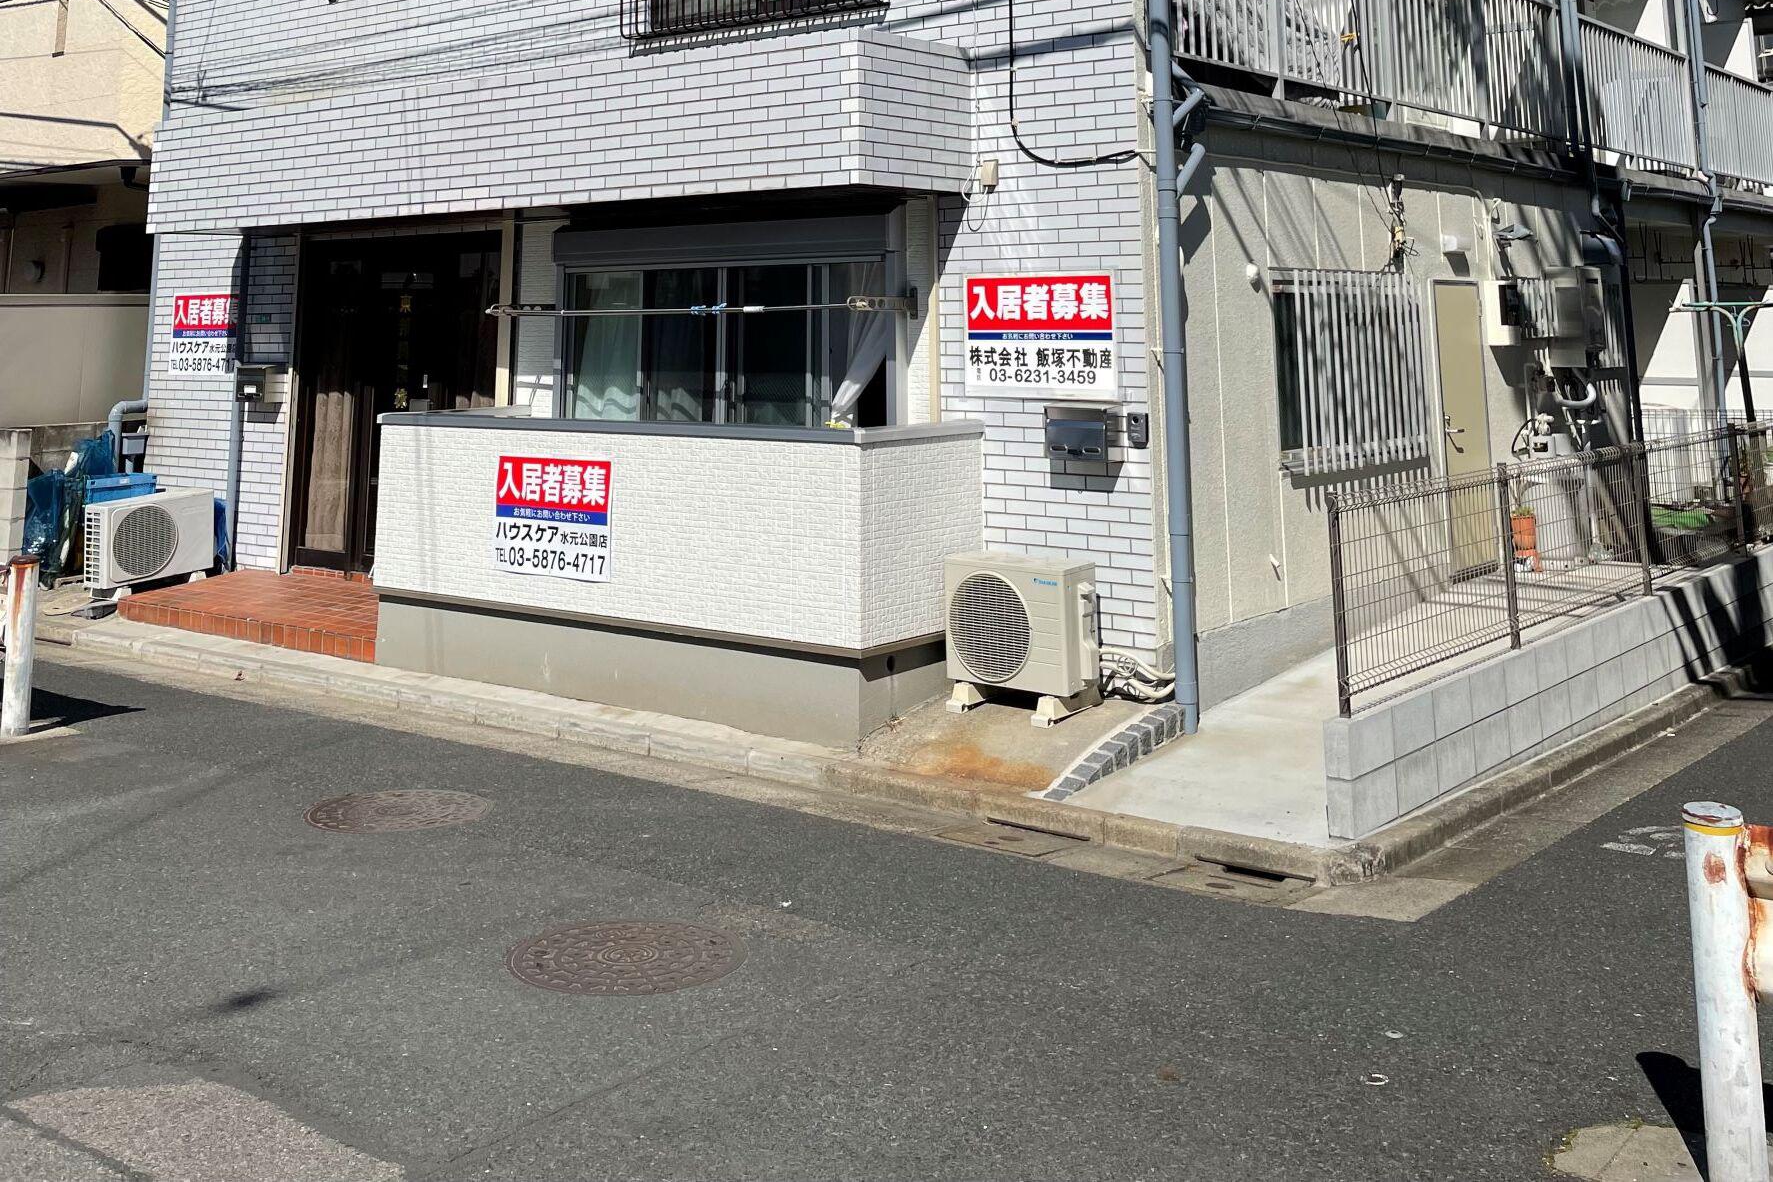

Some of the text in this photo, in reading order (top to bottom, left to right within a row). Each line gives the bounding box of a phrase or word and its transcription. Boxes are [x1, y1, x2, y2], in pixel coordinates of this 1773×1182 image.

[970, 282, 1109, 321] 入居者募集
[970, 346, 1112, 369] 株式会社 飯塚不動産
[989, 368, 1096, 385] 03-6231-3459
[499, 462, 607, 506] 入居者募集
[513, 507, 591, 522] お気軽にお問い合わせ下さい
[508, 546, 606, 575] 03-5876-4717
